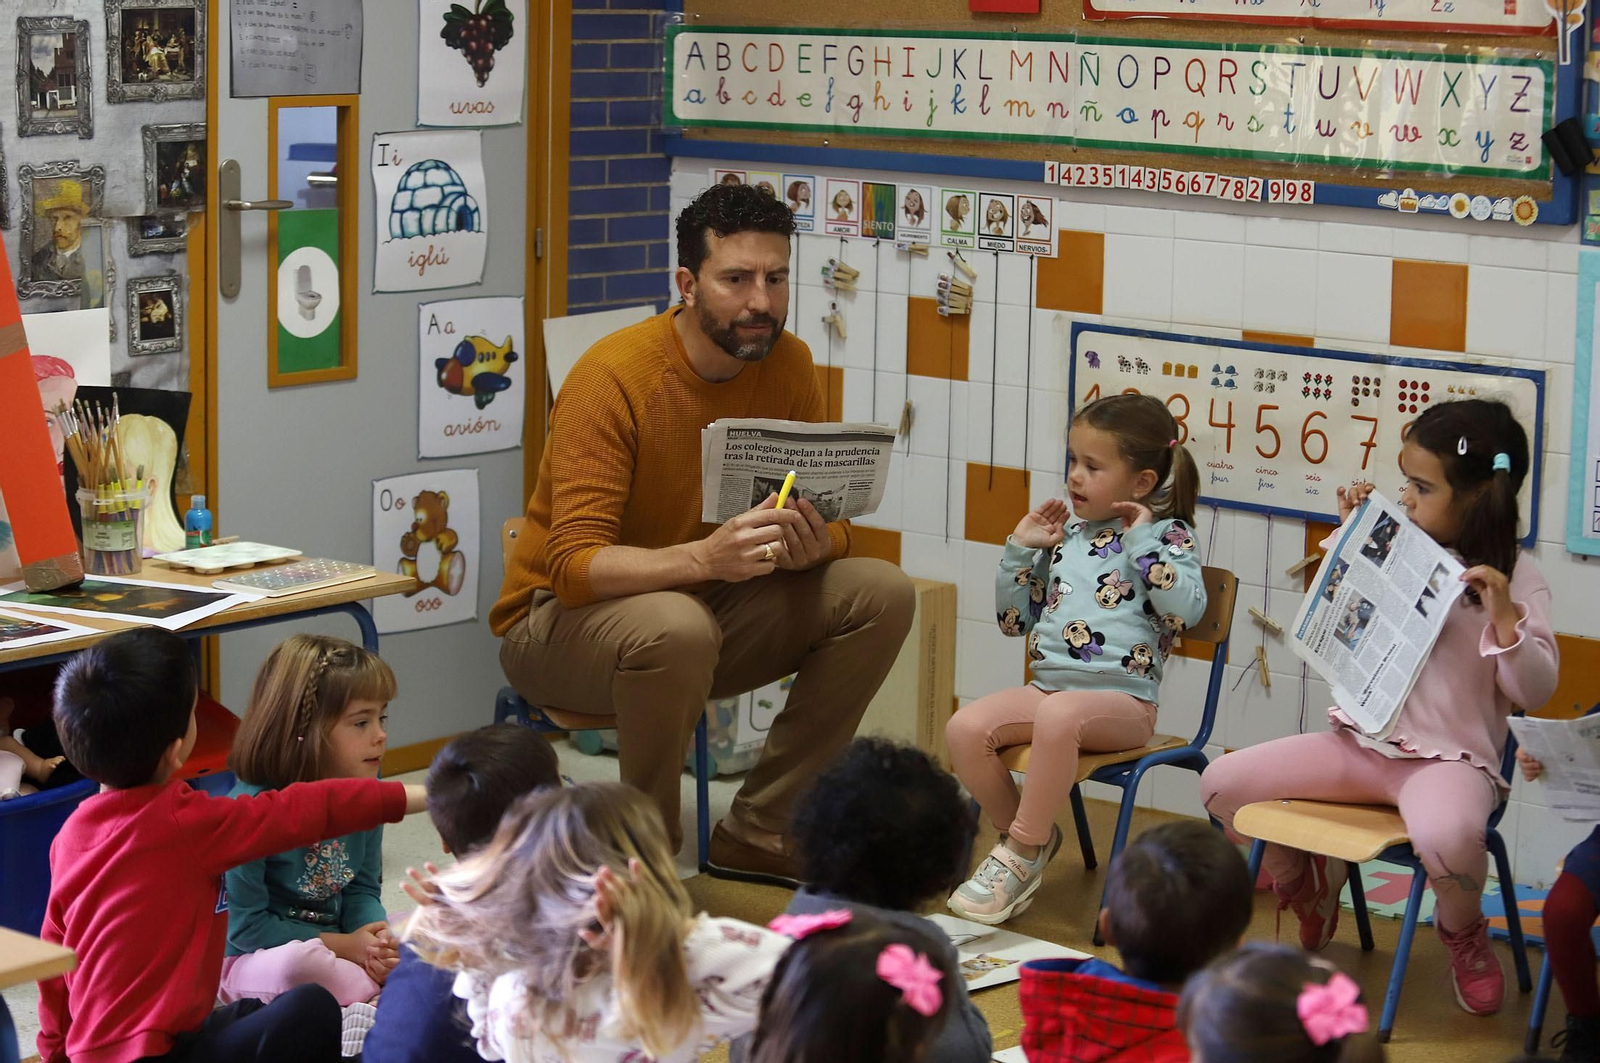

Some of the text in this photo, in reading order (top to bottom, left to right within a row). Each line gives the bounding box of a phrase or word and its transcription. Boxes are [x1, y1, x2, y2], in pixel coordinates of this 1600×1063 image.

[686, 41, 1531, 112] A B C D E F G H I J K L M N Ñ O P Q R S T U V W X Y Z
[450, 100, 494, 114] uvas
[684, 89, 706, 104] a
[716, 77, 731, 104] b
[742, 90, 757, 105] c
[767, 81, 786, 106] d
[796, 93, 812, 107] e
[825, 77, 834, 113] f
[847, 95, 863, 123] g
[873, 81, 890, 110] h
[903, 90, 912, 112] i
[927, 90, 938, 127] j
[951, 84, 966, 114] k
[979, 84, 990, 115] l
[1004, 100, 1035, 117] m
[1047, 102, 1069, 118] n
[1080, 101, 1102, 121] ñ
[1116, 108, 1138, 124] o
[1151, 109, 1170, 139] p
[1183, 111, 1205, 143] q
[1217, 113, 1234, 131] r
[1247, 115, 1264, 132] s
[1283, 103, 1296, 134] t
[1316, 120, 1336, 137] u
[1351, 121, 1374, 139] v
[1390, 125, 1422, 142] w
[1439, 128, 1460, 147] x
[1476, 131, 1495, 163] y
[1510, 132, 1529, 151] z
[863, 220, 894, 231] SIENTO
[947, 237, 968, 246] CALMA
[987, 241, 1006, 249] MIEDO
[407, 245, 450, 276] iglú
[444, 416, 500, 437] avión
[1208, 398, 1235, 453] 4
[1255, 404, 1281, 459] 5
[1300, 411, 1329, 464] 6
[1351, 415, 1377, 470] 7
[725, 442, 742, 451] Los
[744, 442, 782, 454] colegios
[784, 448, 815, 457] apelan
[825, 448, 833, 457] la
[835, 447, 880, 458] prudencia
[724, 452, 876, 467] tras la retirada de las mascarillas
[1207, 460, 1234, 470] cuatro
[1255, 466, 1279, 476] cinco
[1305, 473, 1322, 482] seis
[1210, 472, 1229, 484] four
[1258, 478, 1275, 491] five
[1305, 487, 1319, 496] six
[415, 597, 442, 613] oso
